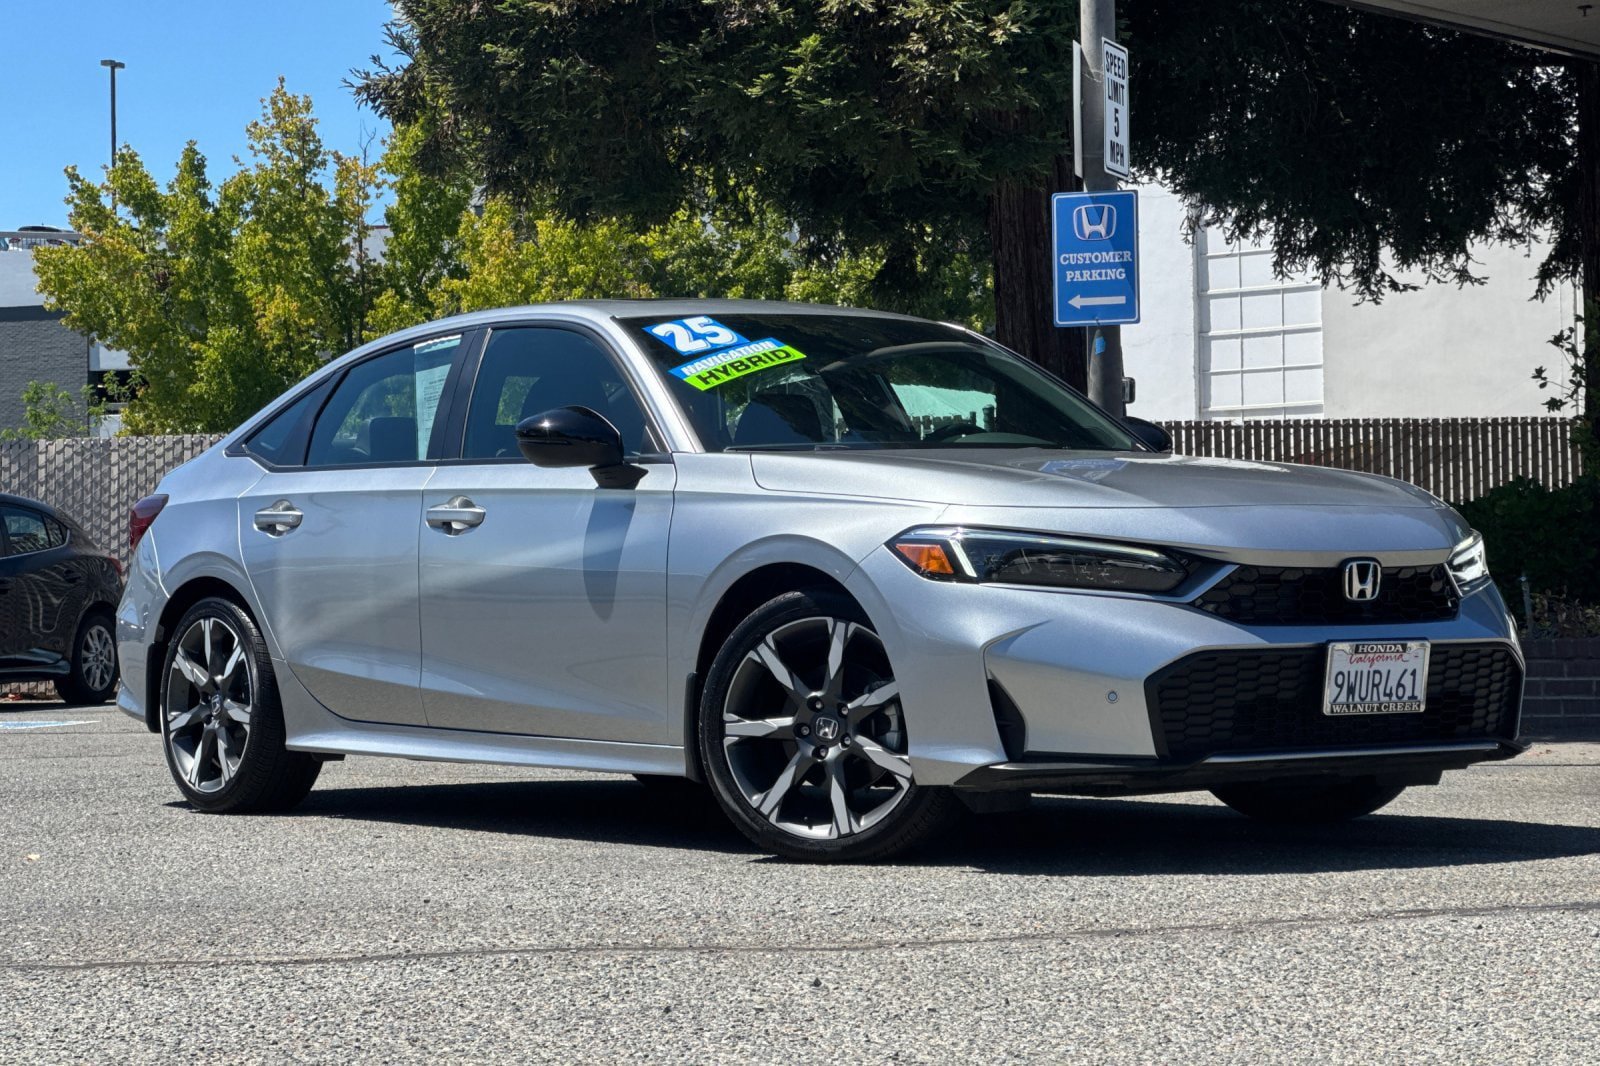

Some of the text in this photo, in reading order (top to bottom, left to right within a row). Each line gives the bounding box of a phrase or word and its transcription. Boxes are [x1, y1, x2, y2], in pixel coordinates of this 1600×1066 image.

[1106, 51, 1125, 80] SPEED
[1108, 77, 1125, 106] LIMIT
[1114, 107, 1120, 138] 5
[1110, 139, 1125, 167] MPH
[1060, 250, 1132, 265] CUSTOMER
[1065, 268, 1126, 282] PARKING
[652, 316, 738, 352] 25
[681, 340, 777, 376] NAVIGATION
[696, 348, 794, 385] HYBRID
[1349, 653, 1409, 668] California
[1358, 644, 1404, 653] HONDA
[1332, 668, 1418, 703] 9WUR461
[1332, 702, 1420, 713] WALNUT CREEK
